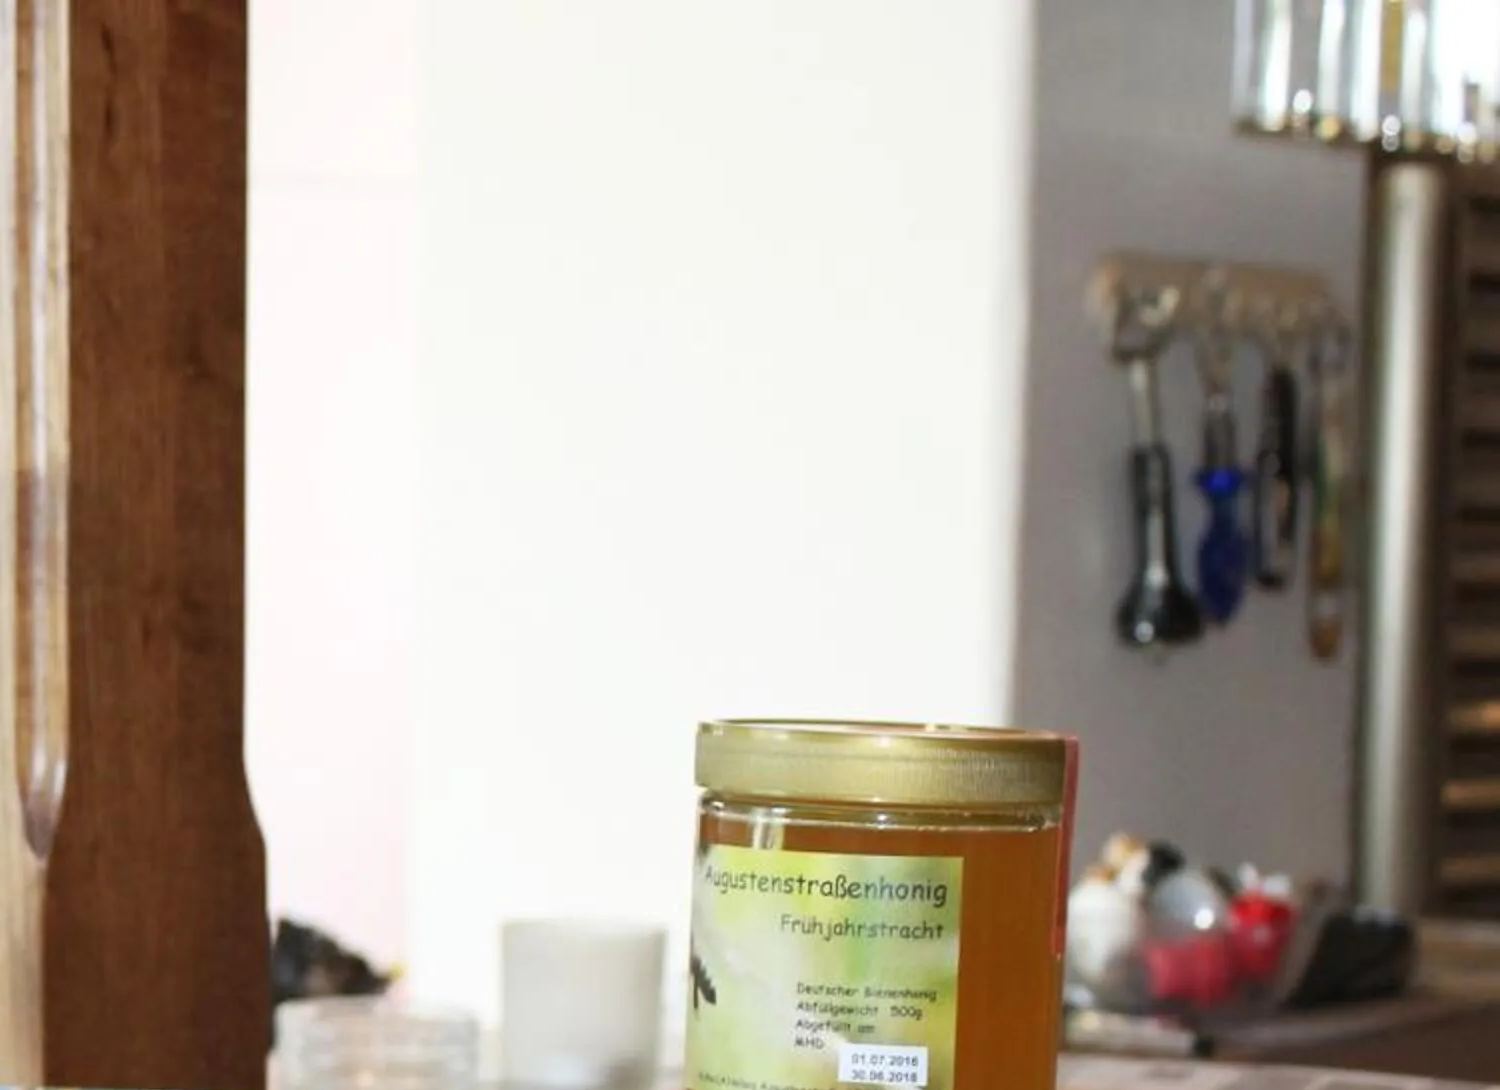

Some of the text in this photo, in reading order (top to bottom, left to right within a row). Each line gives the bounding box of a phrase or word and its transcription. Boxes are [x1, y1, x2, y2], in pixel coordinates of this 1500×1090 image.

[705, 865, 948, 909] Augustenstraßenhonig
[780, 913, 944, 942] Frühjahrstracht
[890, 1005, 923, 1021] 500g
